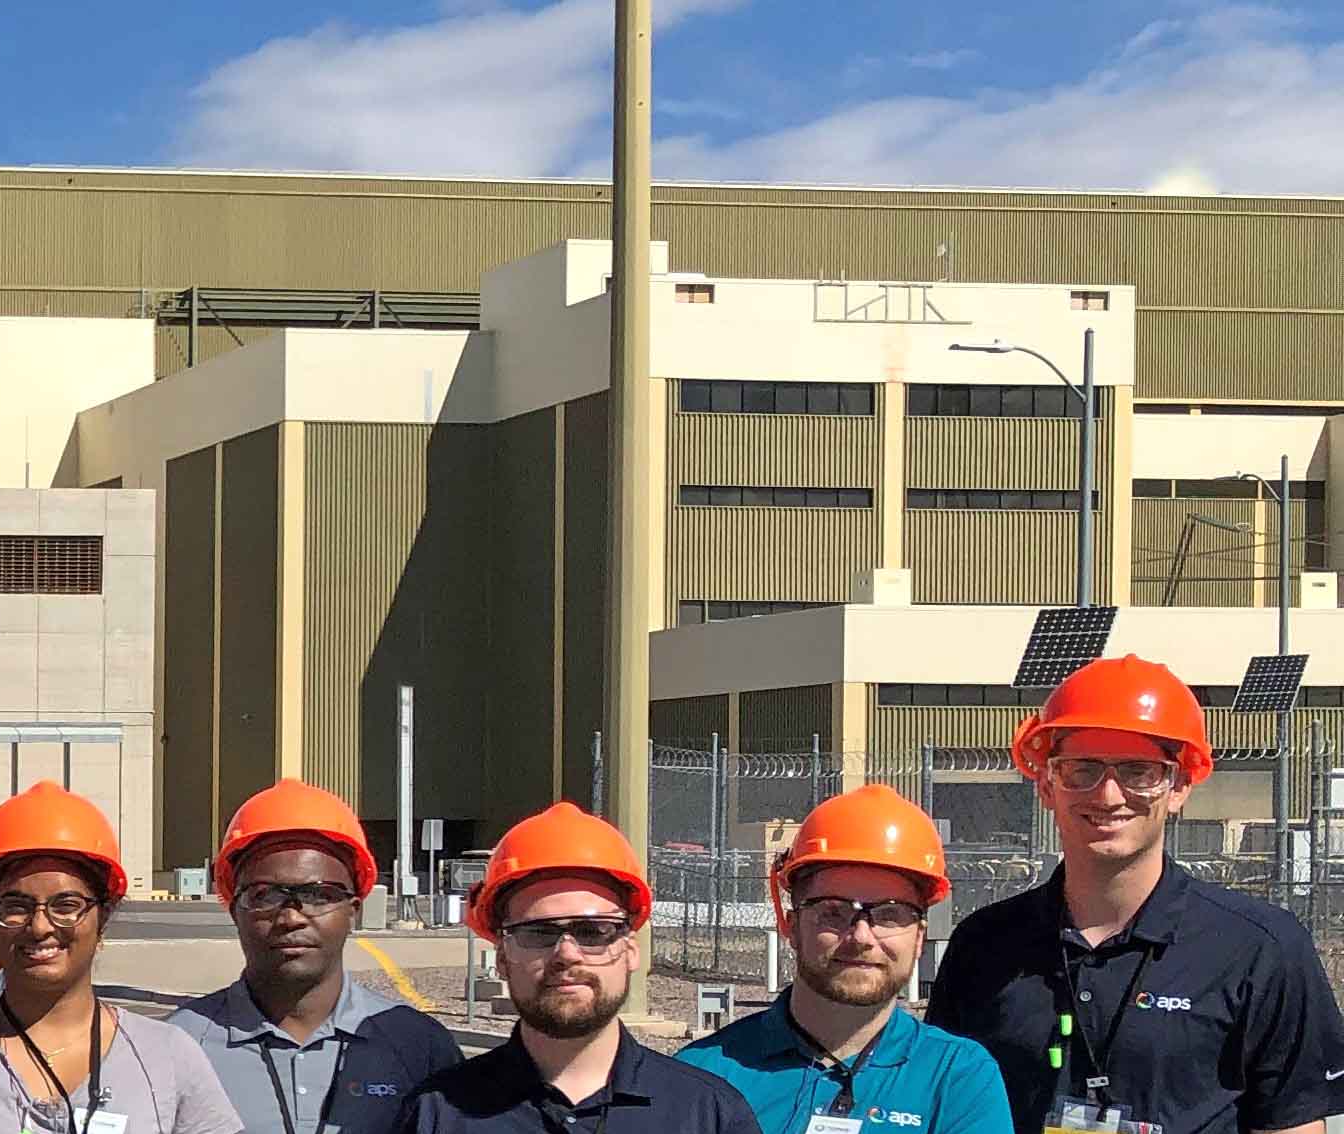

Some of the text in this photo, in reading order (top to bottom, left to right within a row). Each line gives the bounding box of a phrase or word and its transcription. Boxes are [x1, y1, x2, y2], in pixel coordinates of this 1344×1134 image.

[1156, 996, 1192, 1011] aps
[367, 1084, 398, 1096] aps
[888, 1111, 921, 1127] aps
